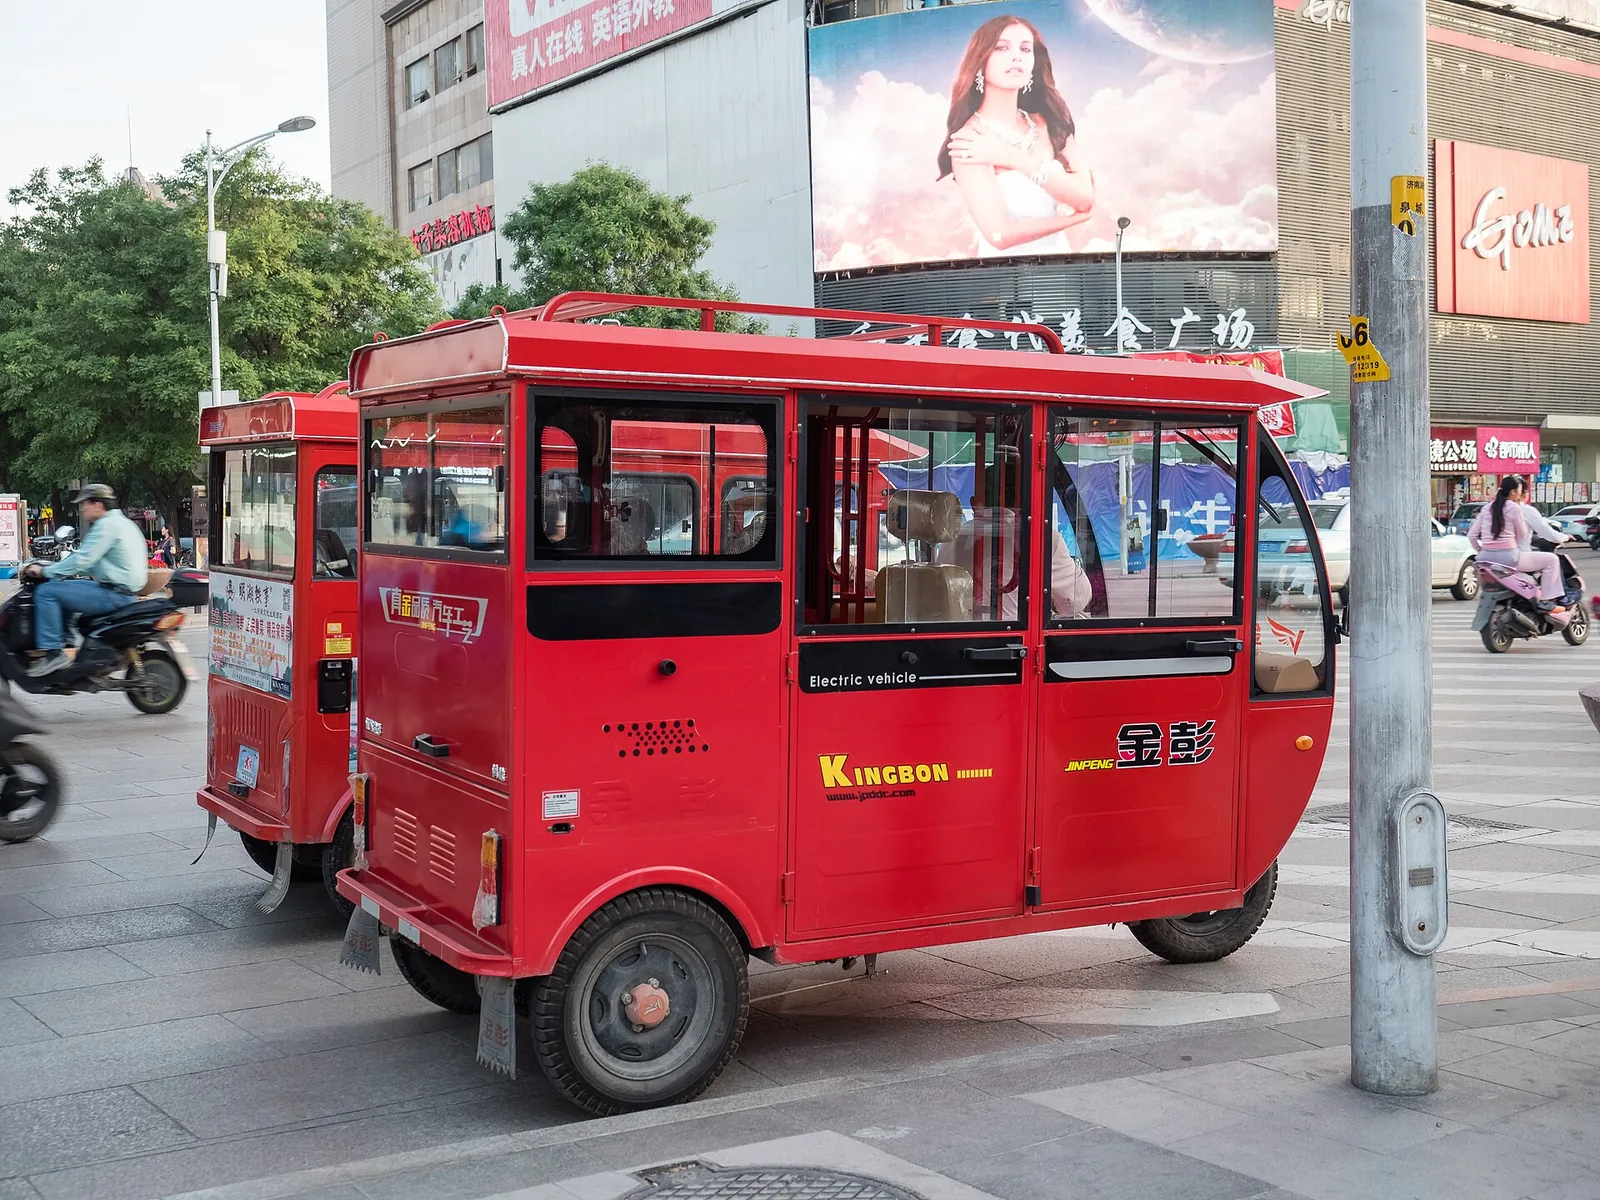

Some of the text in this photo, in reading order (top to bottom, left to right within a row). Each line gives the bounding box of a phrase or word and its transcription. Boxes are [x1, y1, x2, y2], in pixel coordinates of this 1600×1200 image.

[511, 18, 584, 81] 真人在线
[592, 0, 675, 47] 英语外教
[810, 671, 917, 688] Electric vehicle
[1064, 719, 1216, 772] JINPENG 金彭
[818, 754, 950, 788] KINGBON
[826, 788, 917, 802] www.jpddc.com
